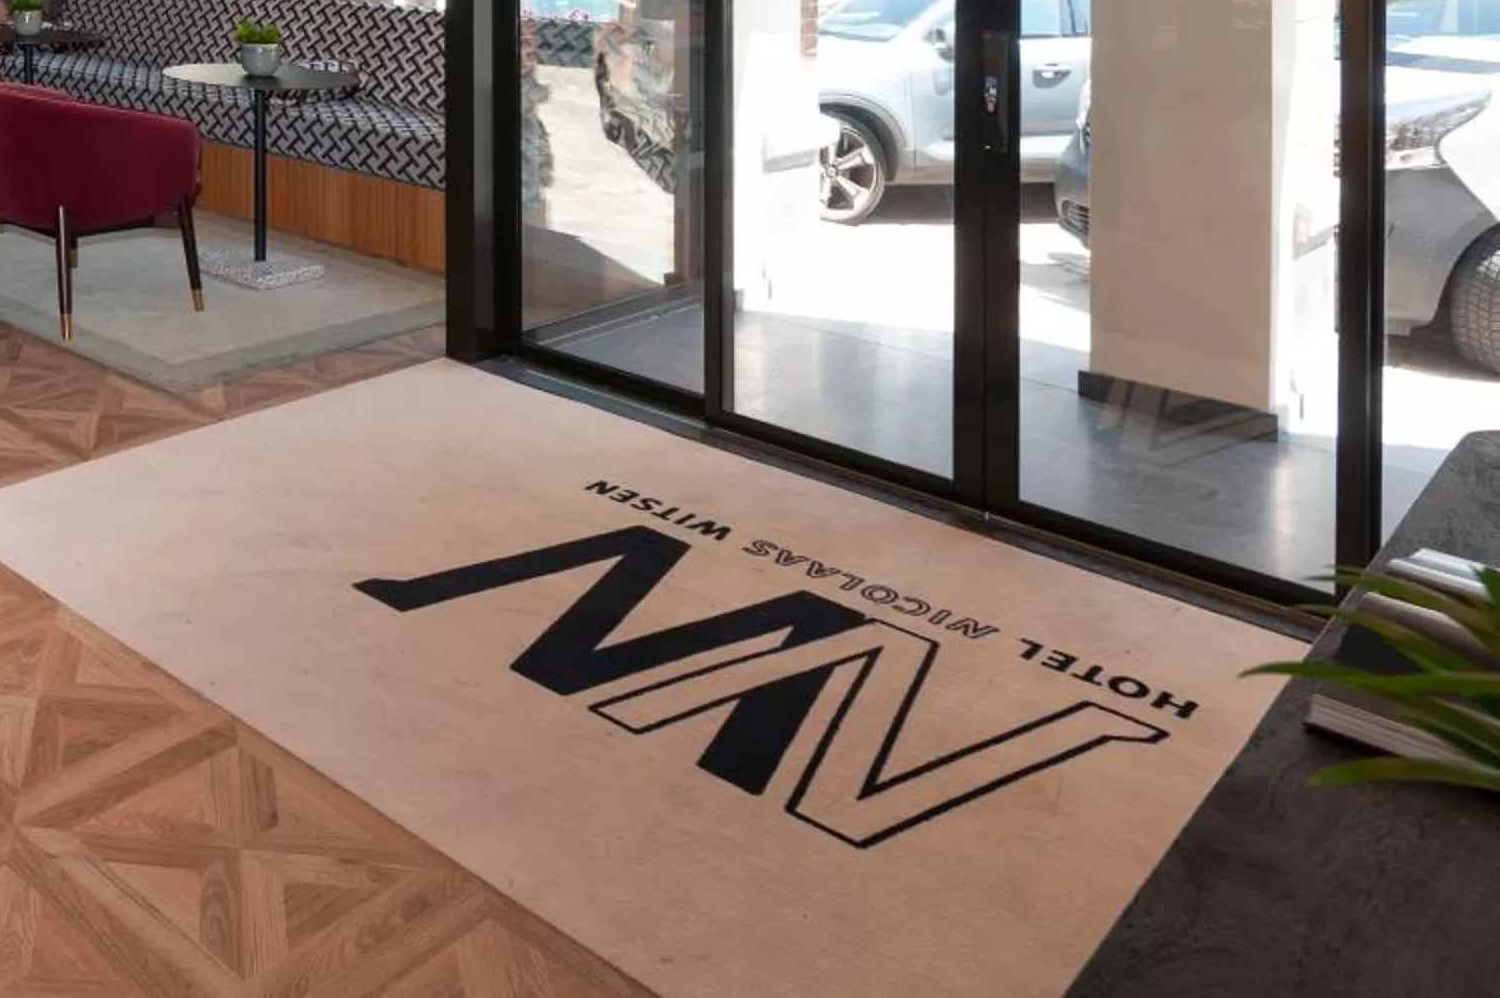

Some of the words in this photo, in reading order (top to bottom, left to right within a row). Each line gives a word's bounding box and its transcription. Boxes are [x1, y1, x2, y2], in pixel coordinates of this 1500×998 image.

[584, 479, 733, 541] WITSEN
[741, 539, 1001, 640] NICOLAAS
[1019, 637, 1199, 720] HOTEL
